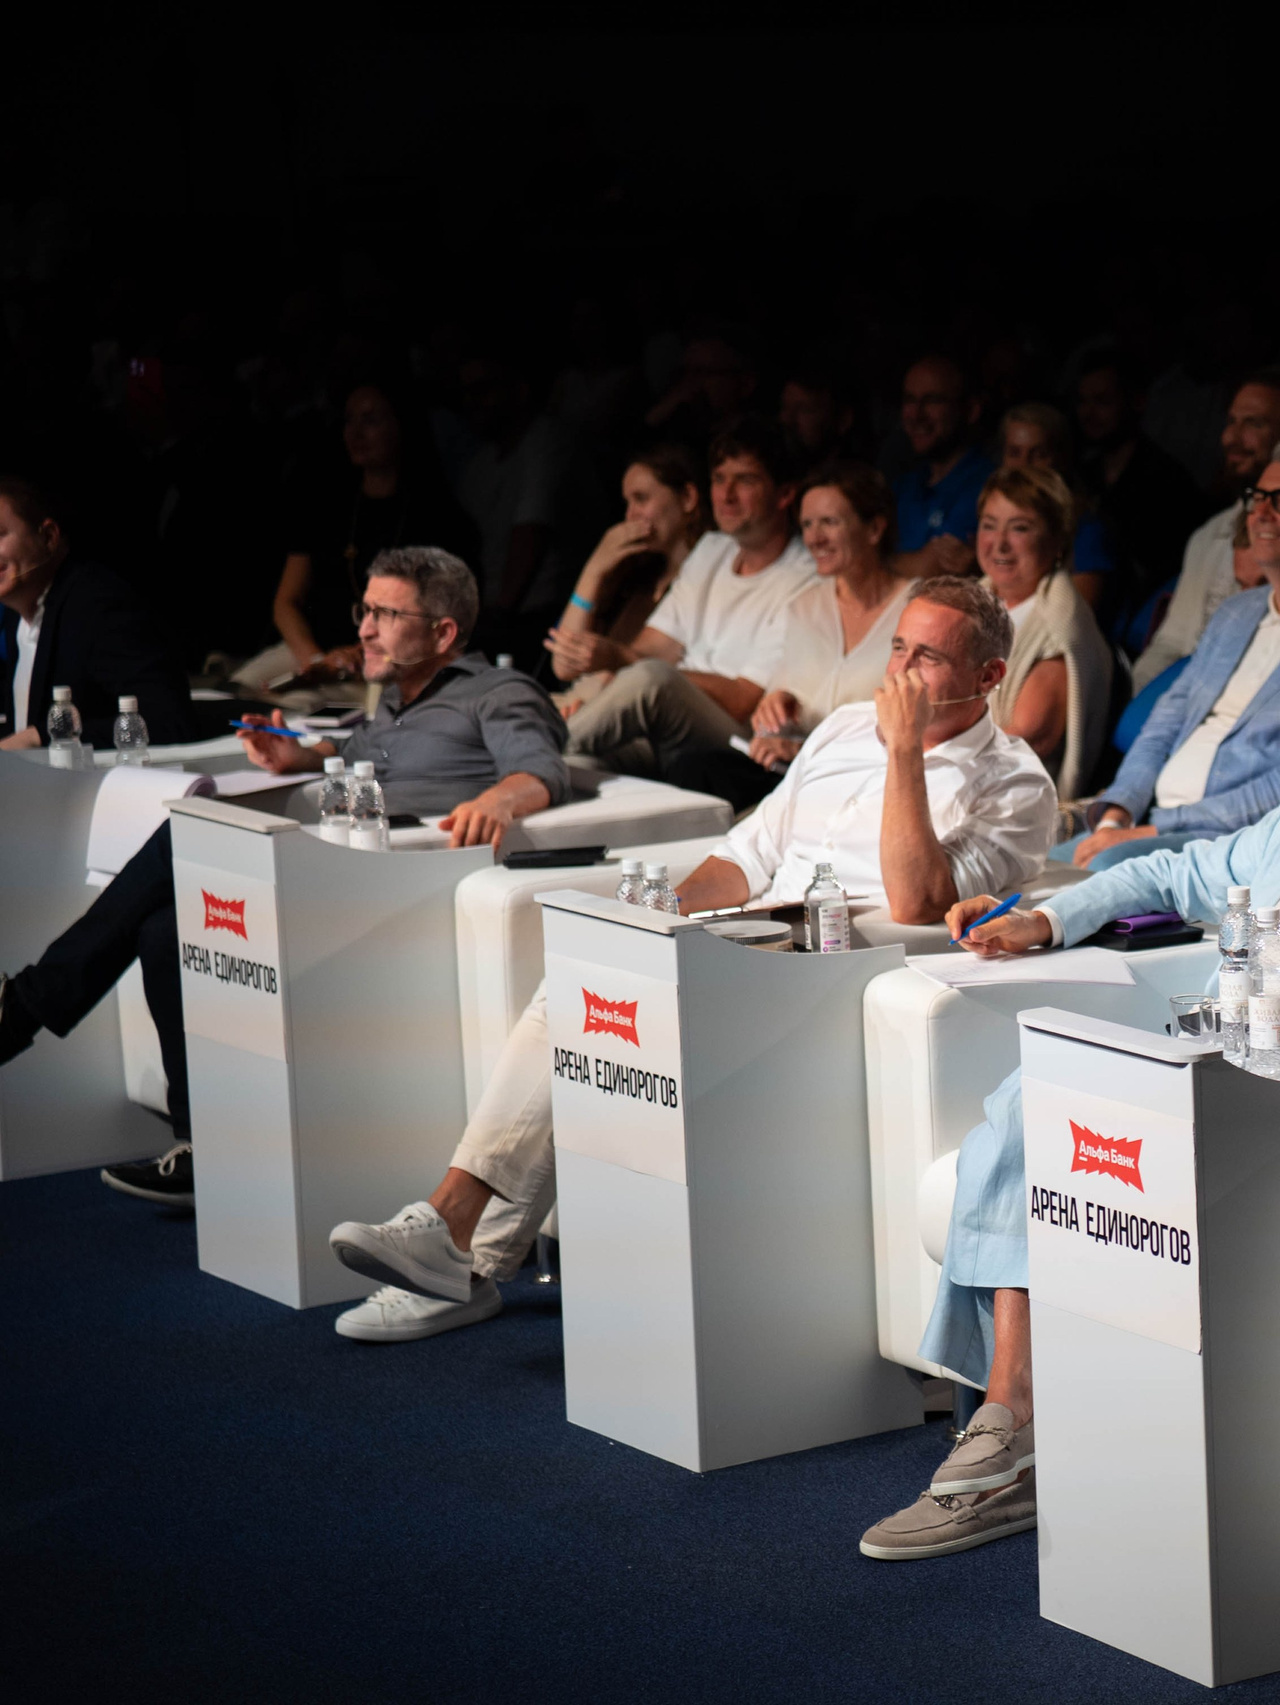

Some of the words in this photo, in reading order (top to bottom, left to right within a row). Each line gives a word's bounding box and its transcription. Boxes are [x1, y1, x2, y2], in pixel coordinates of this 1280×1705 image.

[182, 942, 212, 976] АРЕНА
[214, 951, 277, 994] ЕДИНОРОГОВ
[589, 1004, 613, 1024] Альфа
[613, 1010, 633, 1028] Банк
[554, 1046, 591, 1086] АРЕНА
[595, 1058, 678, 1109] ЕДИНОРОГОВ
[1079, 1140, 1110, 1163] Альфа
[1110, 1148, 1135, 1169] Банк
[1031, 1185, 1079, 1232] АРЕНА
[1086, 1201, 1191, 1265] ЕДИНОРОГОВ
